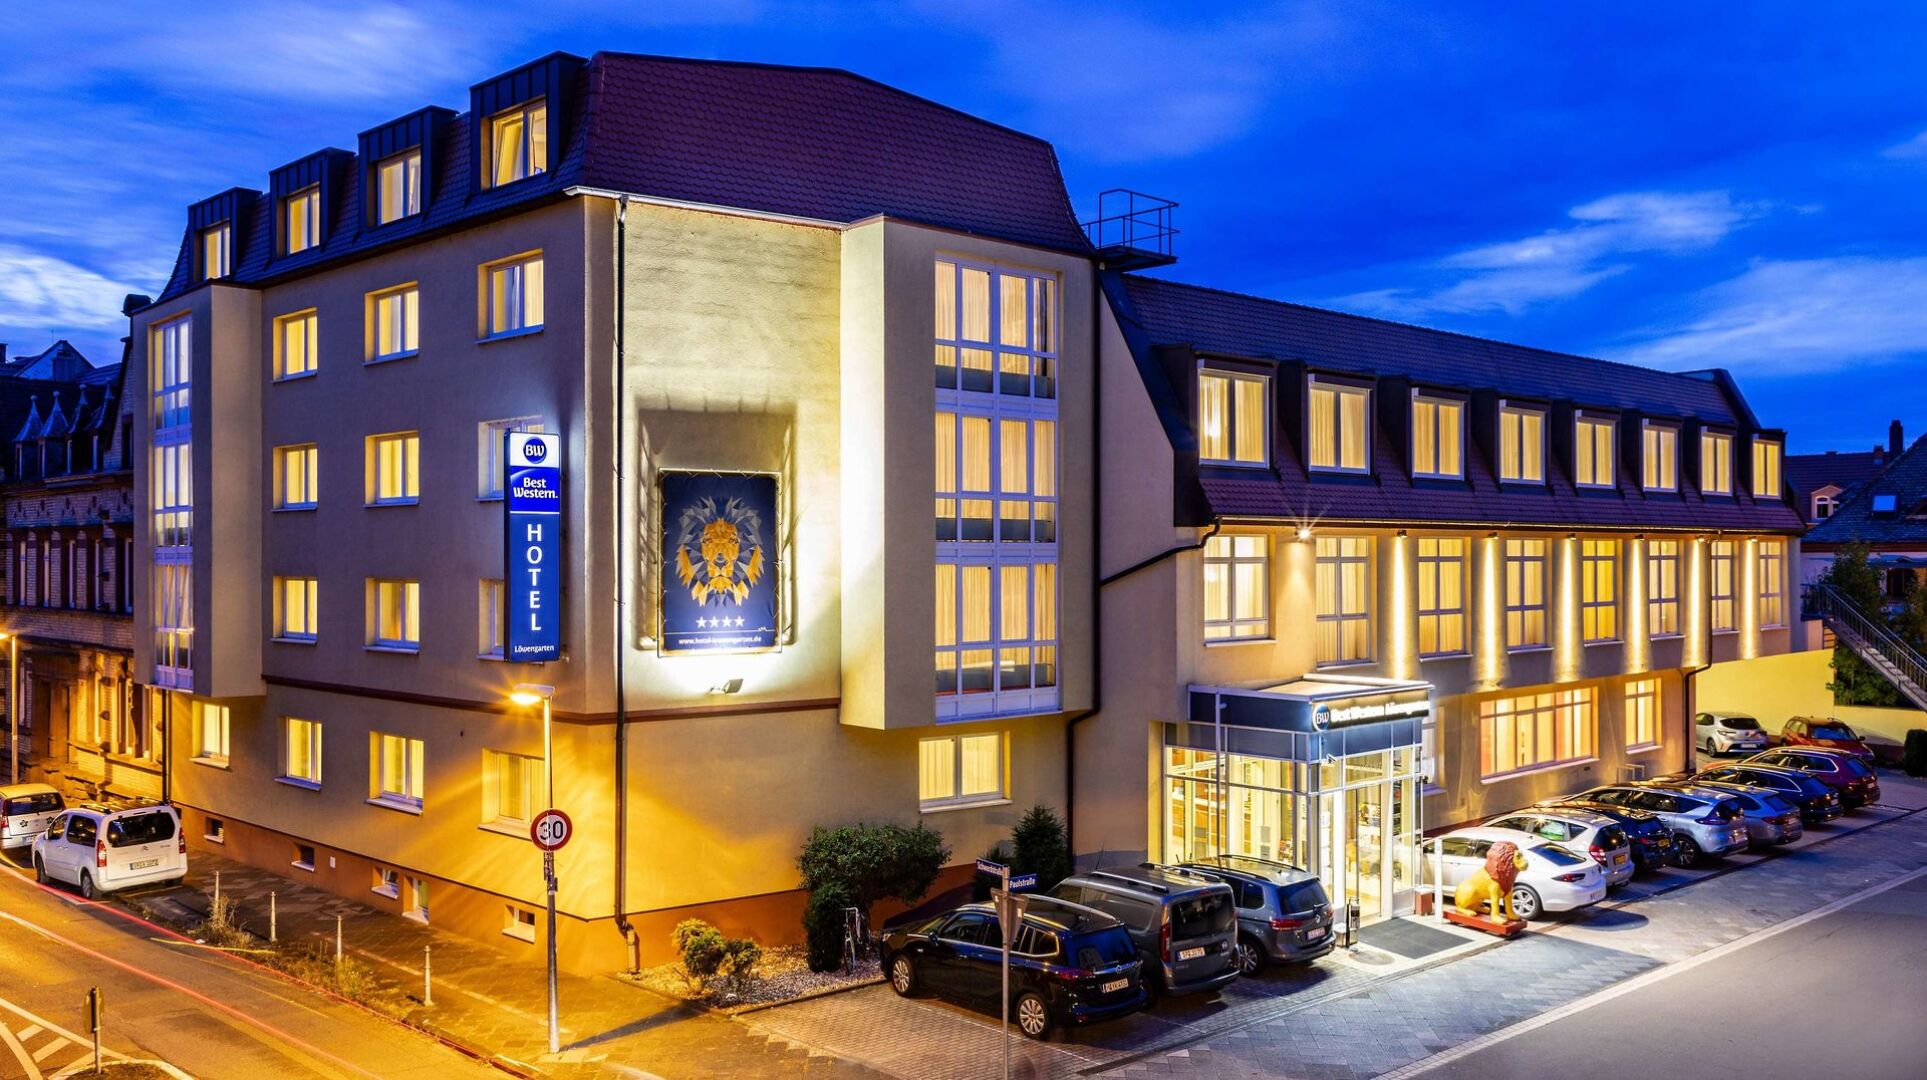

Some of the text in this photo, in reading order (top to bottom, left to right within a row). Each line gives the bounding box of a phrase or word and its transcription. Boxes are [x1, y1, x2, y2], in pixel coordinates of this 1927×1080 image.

[525, 444, 545, 456] BW
[523, 477, 546, 488] Best
[526, 523, 542, 631] HOTEL
[514, 645, 554, 653] Löwengarten
[1316, 711, 1329, 724] BW
[540, 820, 564, 840] 30
